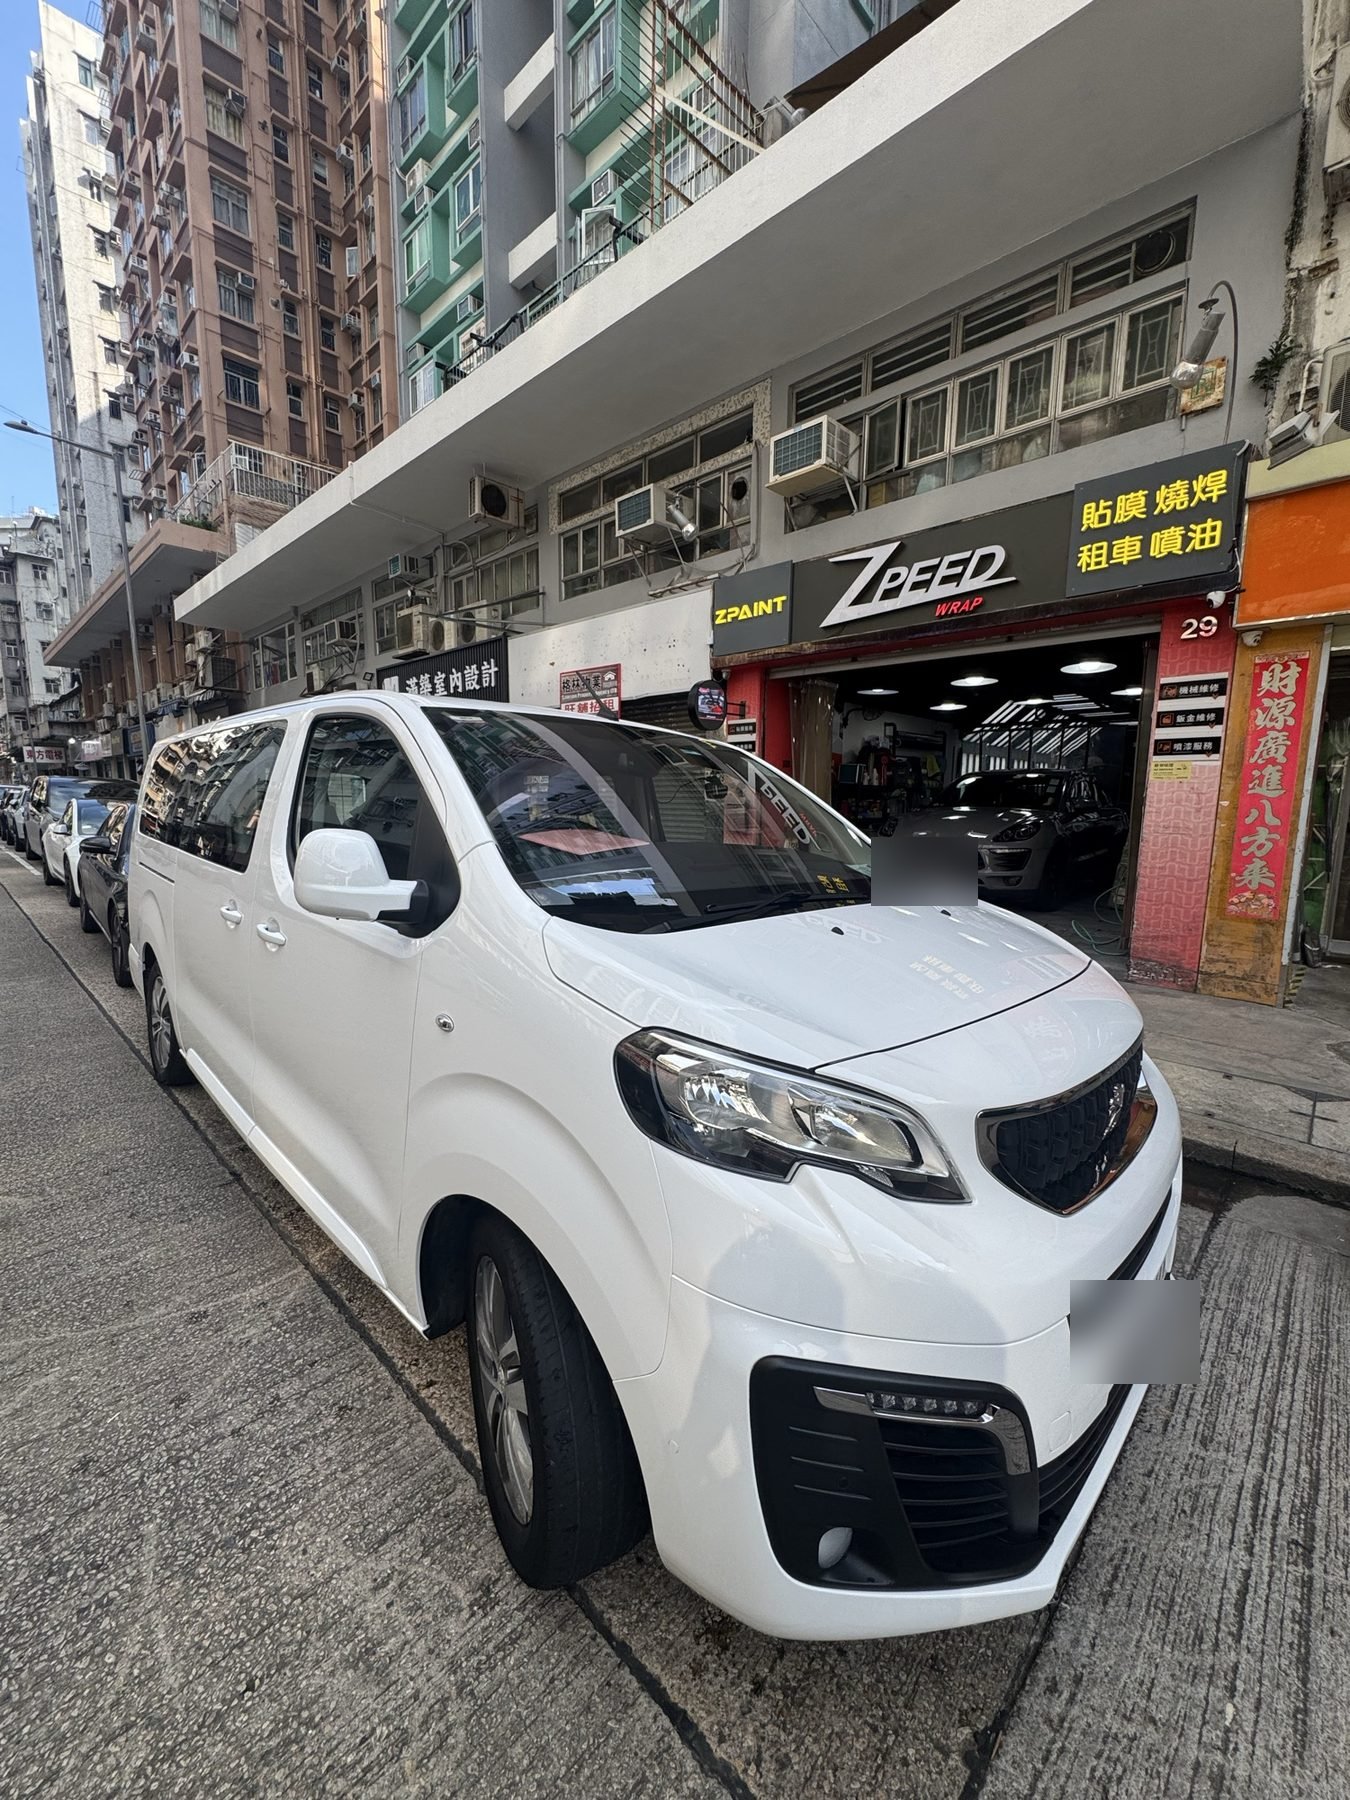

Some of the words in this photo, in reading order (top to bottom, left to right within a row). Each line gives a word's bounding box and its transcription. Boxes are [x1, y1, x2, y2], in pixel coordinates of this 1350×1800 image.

[1080, 489, 1149, 532] 貼膜
[1153, 469, 1228, 516] 燒焊
[1076, 535, 1144, 573] 租車
[1150, 518, 1223, 559] 噴油
[819, 540, 1017, 628] ZPEED
[714, 595, 787, 625] ZPAINT
[934, 596, 984, 618] WRAP
[1180, 615, 1219, 640] 29
